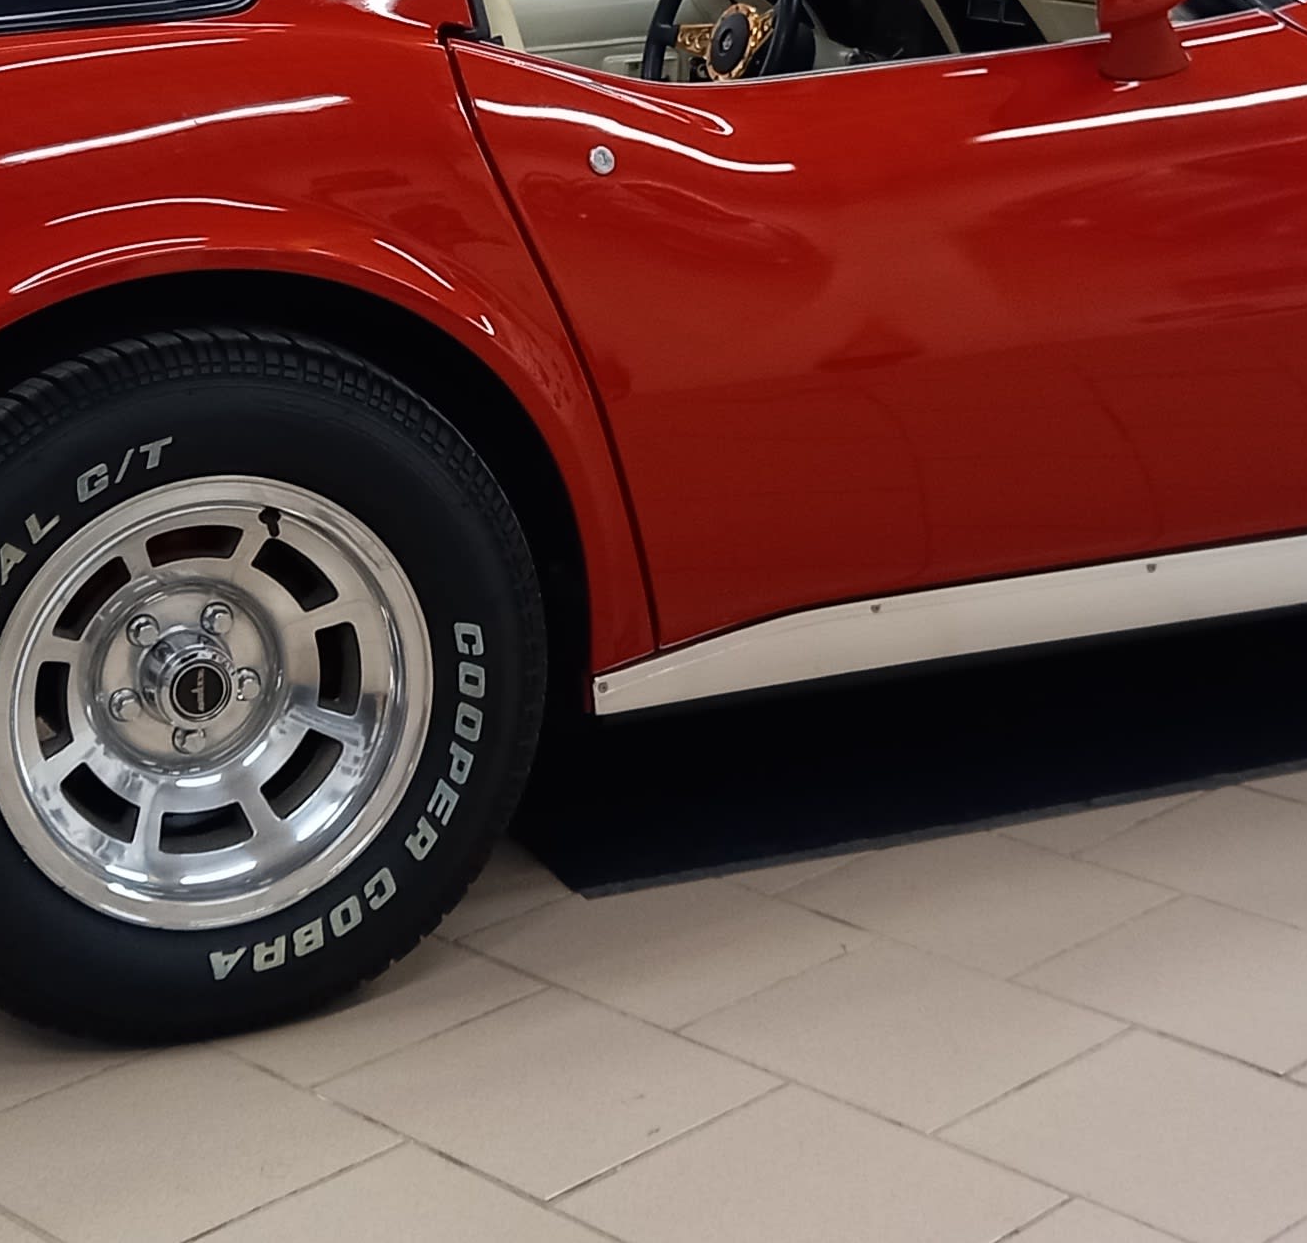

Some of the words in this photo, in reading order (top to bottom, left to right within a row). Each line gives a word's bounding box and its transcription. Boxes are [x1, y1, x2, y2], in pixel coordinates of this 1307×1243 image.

[76, 436, 173, 503] G/T
[404, 622, 486, 861] COOPER
[208, 866, 397, 981] COBRA
